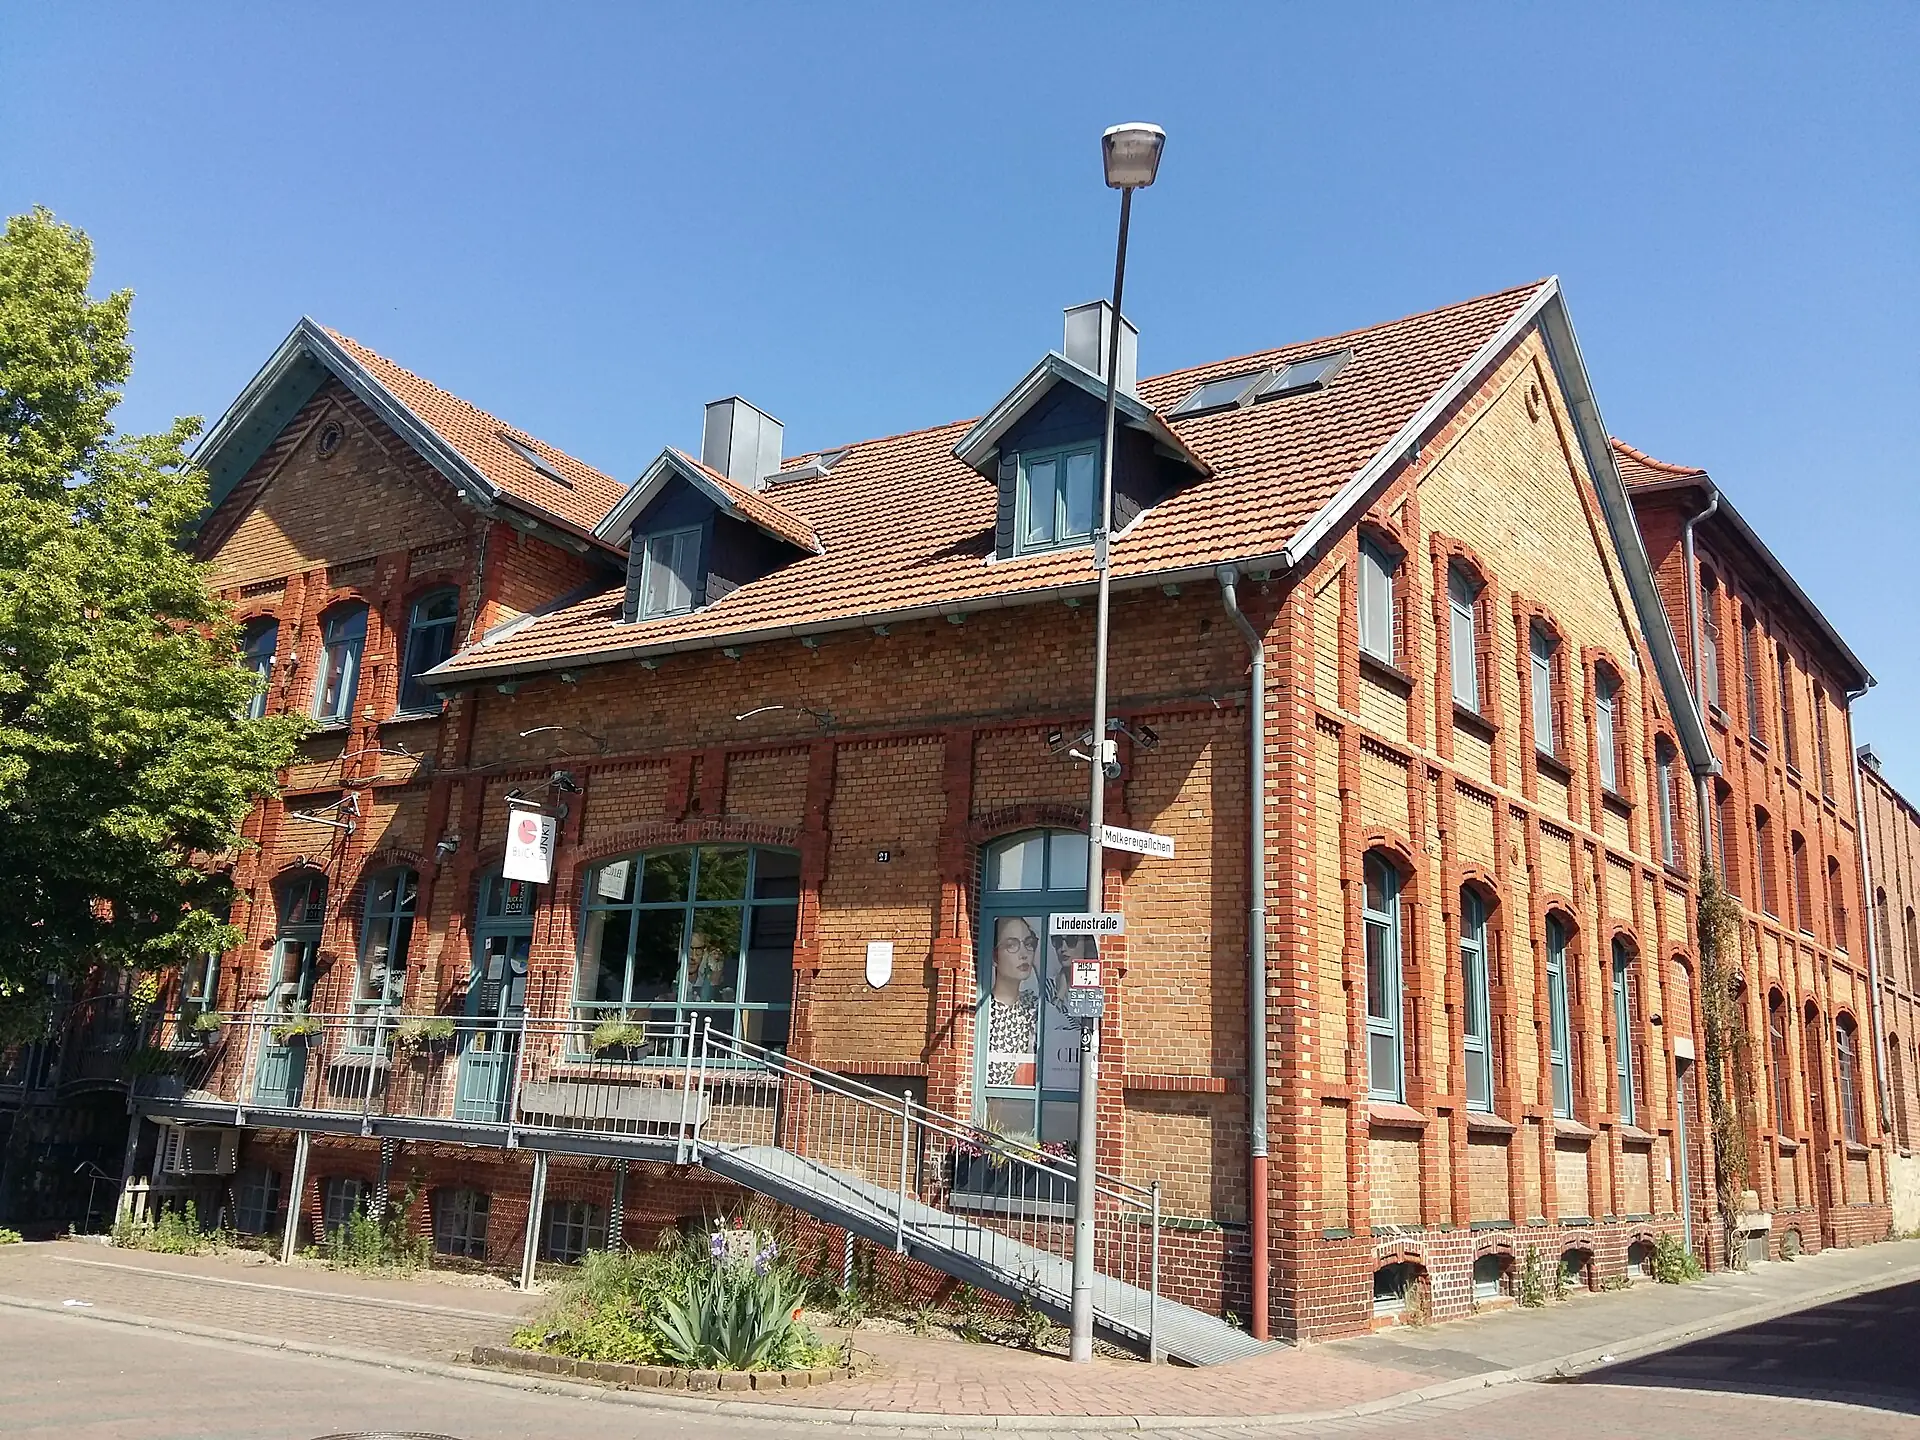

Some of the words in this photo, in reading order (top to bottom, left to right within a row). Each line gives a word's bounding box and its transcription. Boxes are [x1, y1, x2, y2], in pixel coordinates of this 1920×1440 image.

[539, 822, 550, 861] PUNKT
[878, 852, 888, 861] 21
[1056, 916, 1118, 930] Lindenstraße
